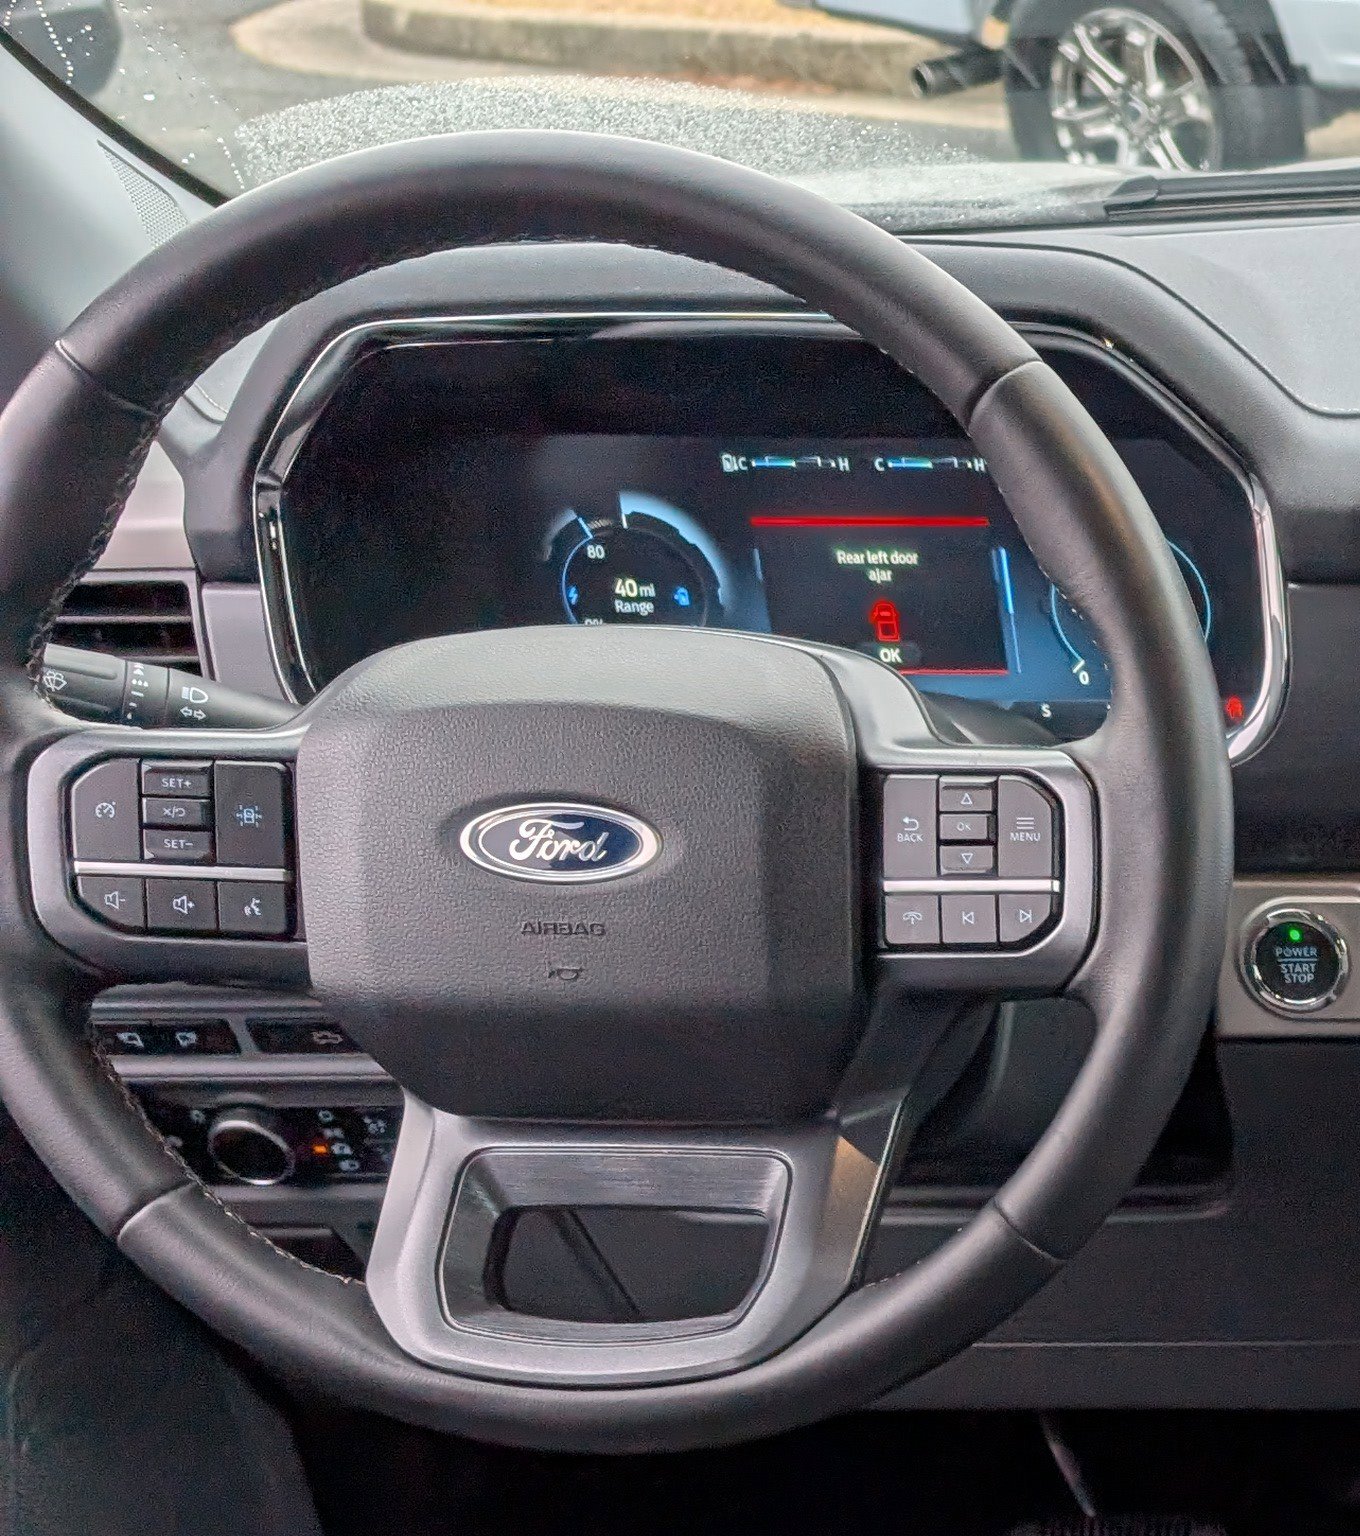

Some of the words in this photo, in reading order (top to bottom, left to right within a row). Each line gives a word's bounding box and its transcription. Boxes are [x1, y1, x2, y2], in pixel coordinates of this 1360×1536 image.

[839, 457, 849, 471] H
[874, 457, 884, 471] C
[974, 457, 986, 472] H
[586, 545, 605, 559] 80
[836, 551, 865, 565] Rear
[866, 550, 889, 565] left
[891, 551, 919, 565] door
[868, 568, 892, 583] ajar
[615, 578, 638, 597] 40
[639, 583, 656, 597] mi
[614, 600, 655, 616] Range
[879, 648, 902, 663] OK
[1078, 670, 1089, 686] 0
[1040, 702, 1052, 718] S
[956, 822, 972, 831] OK
[509, 818, 609, 862] Ford
[897, 833, 924, 843] BACK
[1010, 832, 1040, 842] MENU
[521, 920, 606, 936] AIRBAG
[1275, 946, 1318, 957] POWER
[1280, 963, 1316, 973] START
[1284, 973, 1314, 984] STOP
